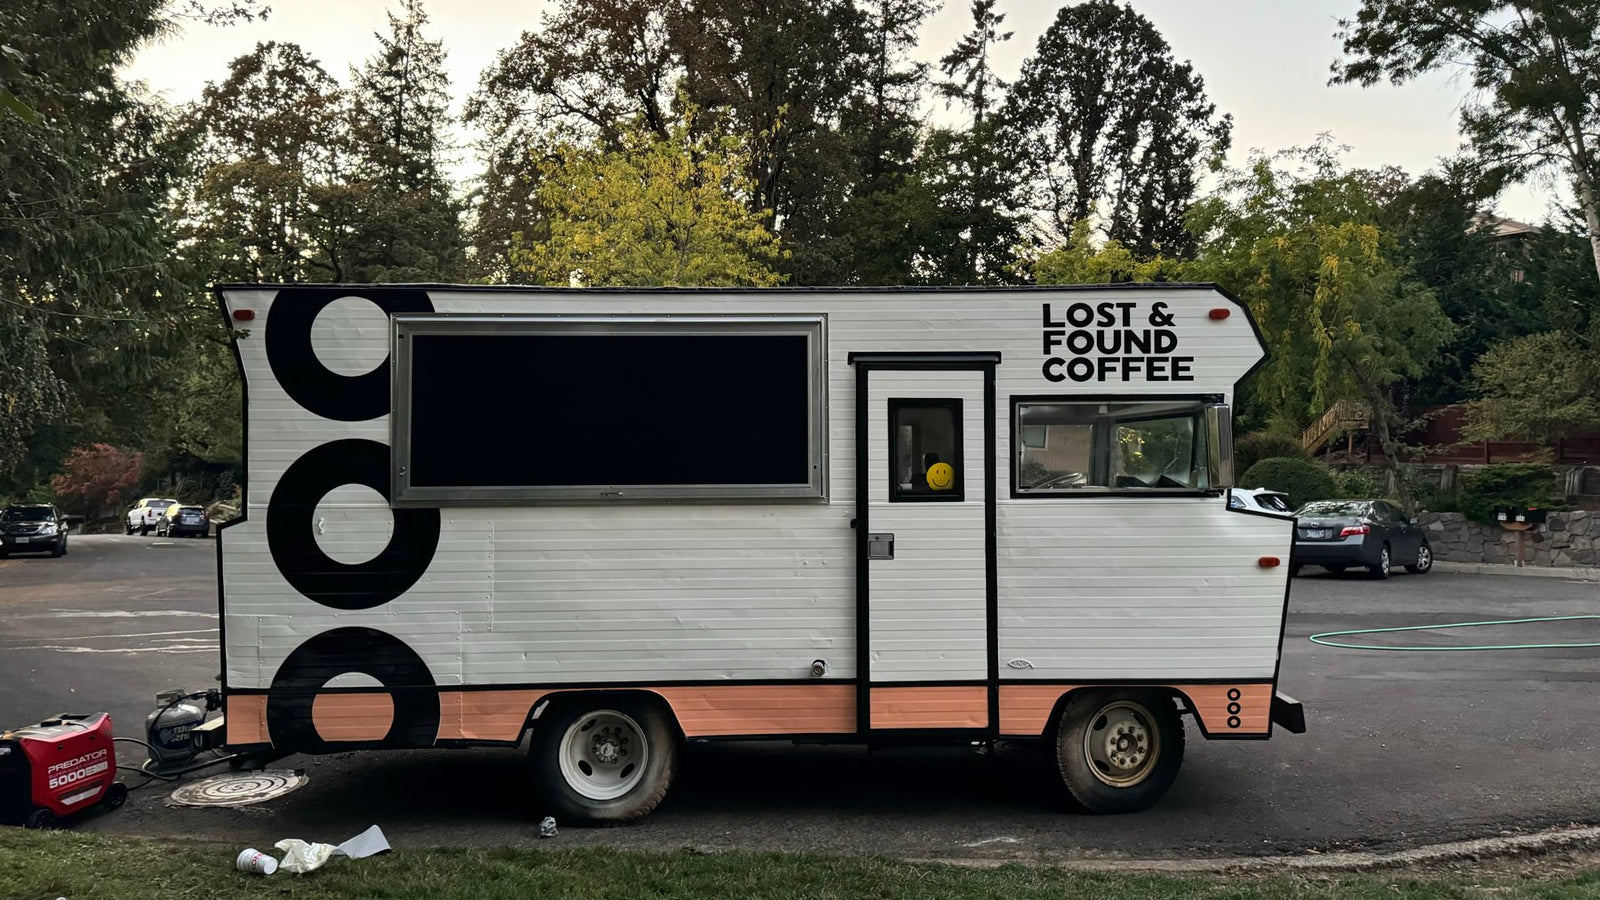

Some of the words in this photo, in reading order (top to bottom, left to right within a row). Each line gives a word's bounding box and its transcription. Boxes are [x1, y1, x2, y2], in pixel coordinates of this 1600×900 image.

[1043, 302, 1136, 327] LOST
[1148, 302, 1176, 327] &
[1043, 329, 1178, 355] FOUND
[1042, 356, 1194, 382] COFFEE
[48, 749, 107, 774] PREDATOR
[49, 768, 86, 789] 5000
